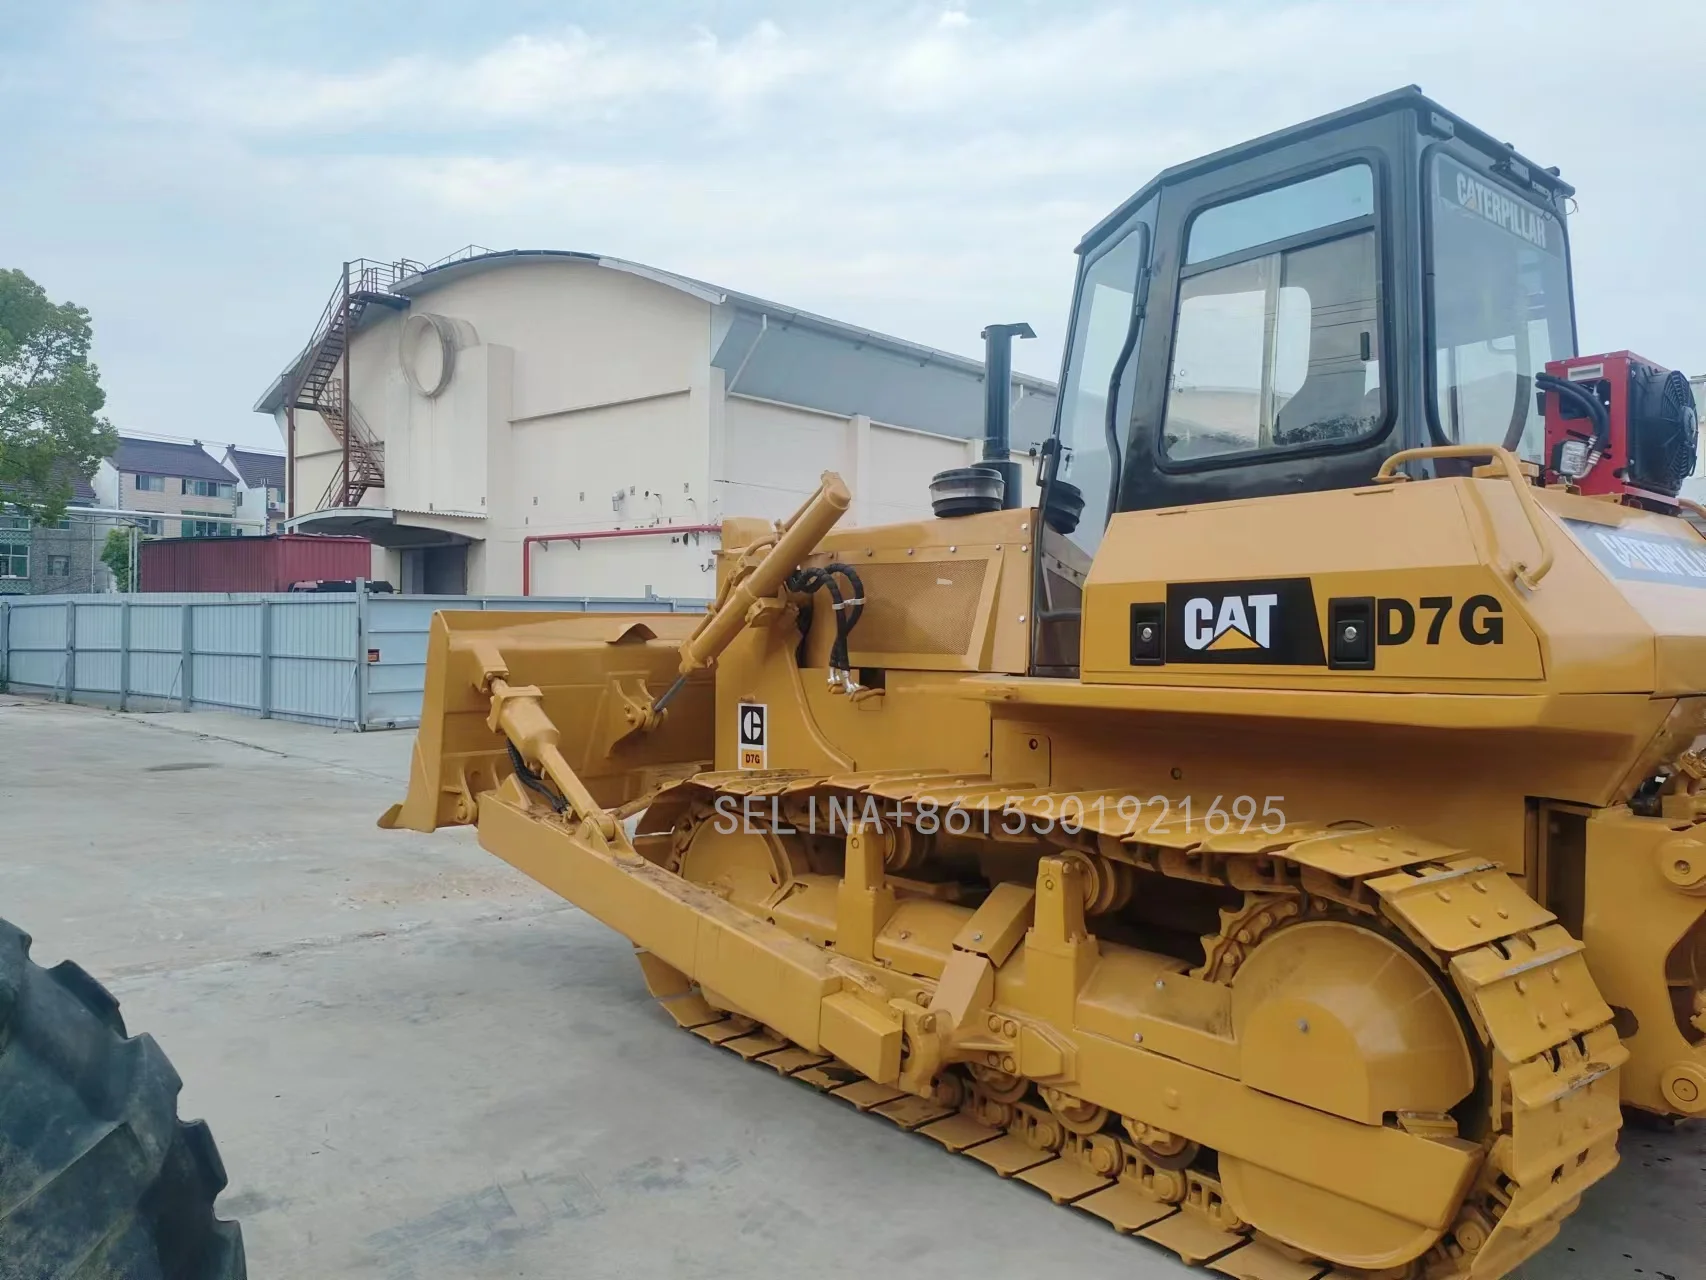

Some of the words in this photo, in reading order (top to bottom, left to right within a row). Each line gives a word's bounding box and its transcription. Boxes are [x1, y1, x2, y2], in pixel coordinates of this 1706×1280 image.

[1456, 172, 1547, 249] CATERPILLAR
[1594, 532, 1706, 578] CATERPILL
[1184, 594, 1278, 651] CAT
[1377, 594, 1504, 646] D7G
[745, 753, 761, 764] D7G
